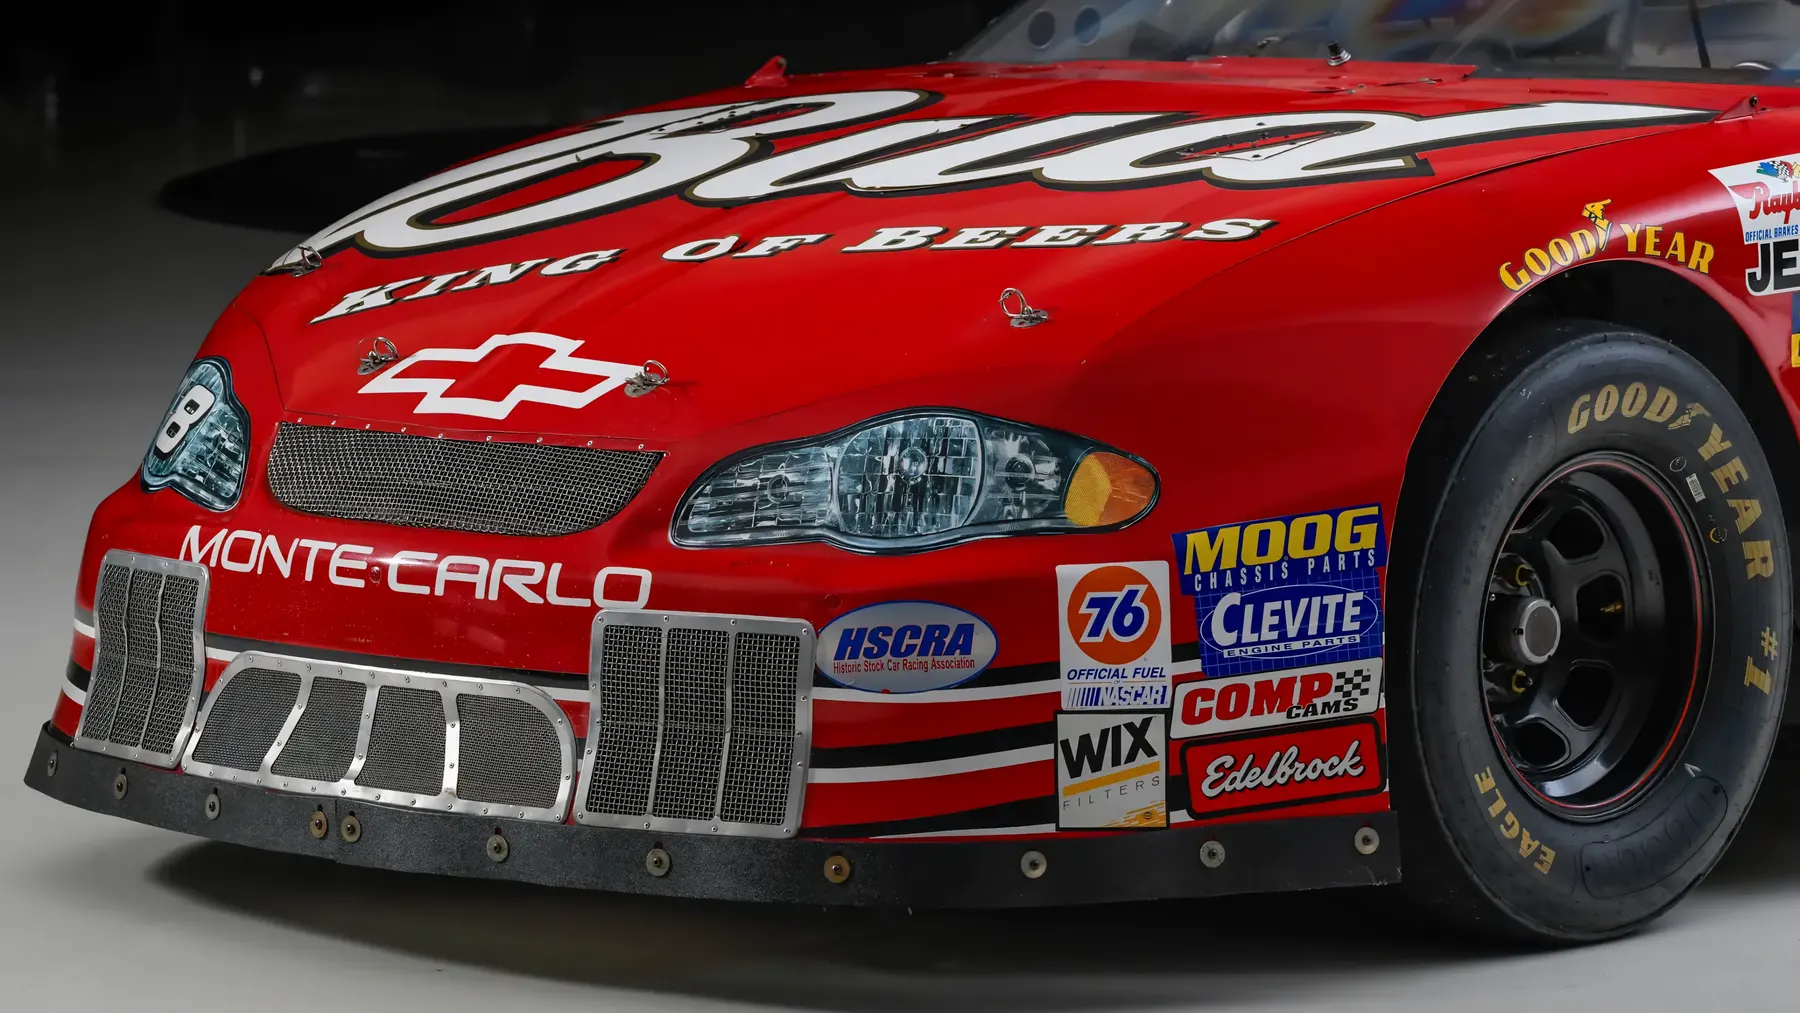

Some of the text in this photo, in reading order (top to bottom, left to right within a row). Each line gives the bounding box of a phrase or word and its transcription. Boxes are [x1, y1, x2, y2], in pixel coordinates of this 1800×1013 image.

[266, 89, 1714, 273] Bud
[1745, 223, 1799, 243] OFFICIAL BRAKES
[310, 217, 1276, 325] KING OF BEERS
[155, 384, 216, 454] 8
[179, 525, 653, 610] MONTE CARLO
[1184, 506, 1379, 575] MOOG
[1194, 548, 1376, 592] CHASSIS PARTS
[833, 623, 975, 661] HSCRA
[1080, 586, 1149, 642] 76
[1211, 590, 1364, 646] CLEVITE
[833, 656, 975, 674] Historic Stock Car Racing Association
[1067, 667, 1166, 681] OFFICIAL FUEL
[1226, 634, 1358, 658] ENGINE PARTS
[1743, 626, 1780, 697] #1
[1100, 685, 1167, 706] NASCAR
[1180, 671, 1334, 726] COMP
[1285, 697, 1359, 721] CAMS
[1059, 716, 1158, 780] WIX
[1201, 740, 1366, 799] Edelbrock
[1063, 775, 1160, 811] FILTERS
[1473, 766, 1556, 877] EAGLE
